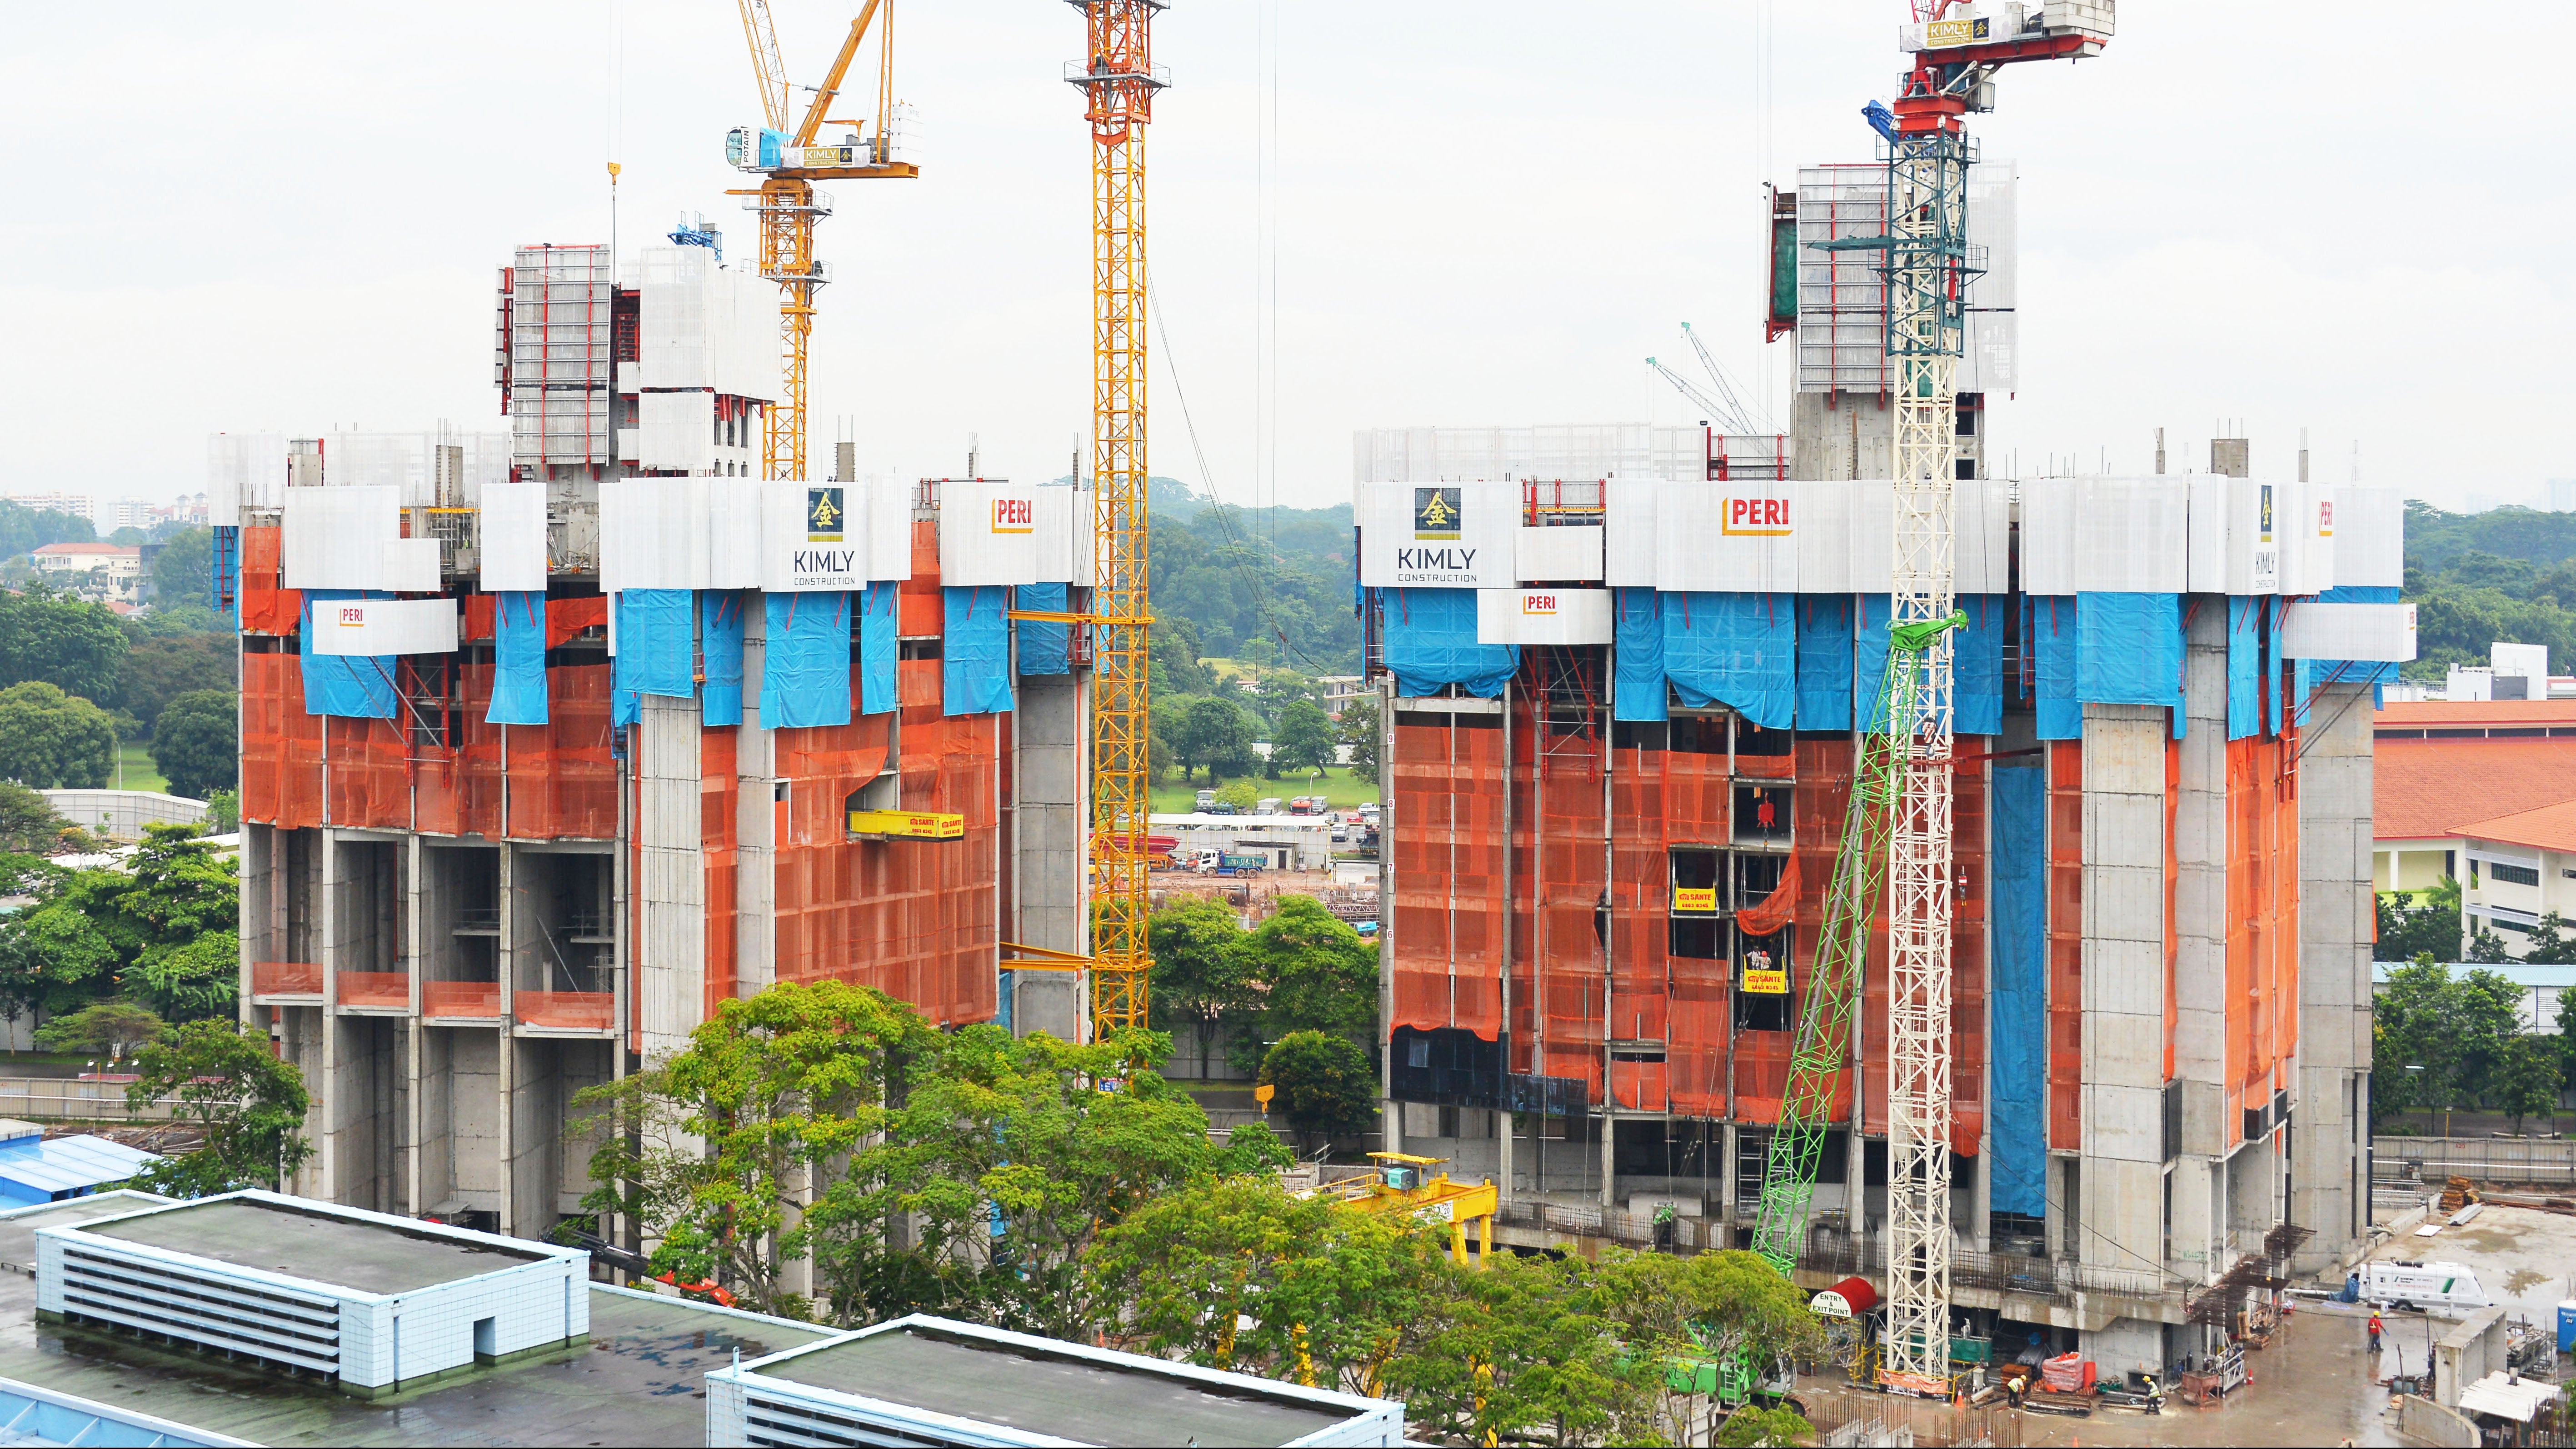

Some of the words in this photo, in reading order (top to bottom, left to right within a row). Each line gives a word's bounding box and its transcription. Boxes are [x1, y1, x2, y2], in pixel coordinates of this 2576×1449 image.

[1931, 23, 1969, 36] KIMLY
[806, 150, 837, 159] KIMLY
[998, 500, 1031, 523] PERI
[1732, 500, 1788, 525] PERI
[2321, 501, 2332, 526] PERI
[794, 551, 854, 572] KIMLY
[1398, 549, 1476, 569] KIMLY
[2256, 552, 2275, 574] KIMLY
[794, 577, 855, 585] CONSTRUCTION
[1398, 574, 1477, 582] CONSTRUCTION
[1528, 596, 1555, 609] PERI
[343, 609, 362, 621] PERI
